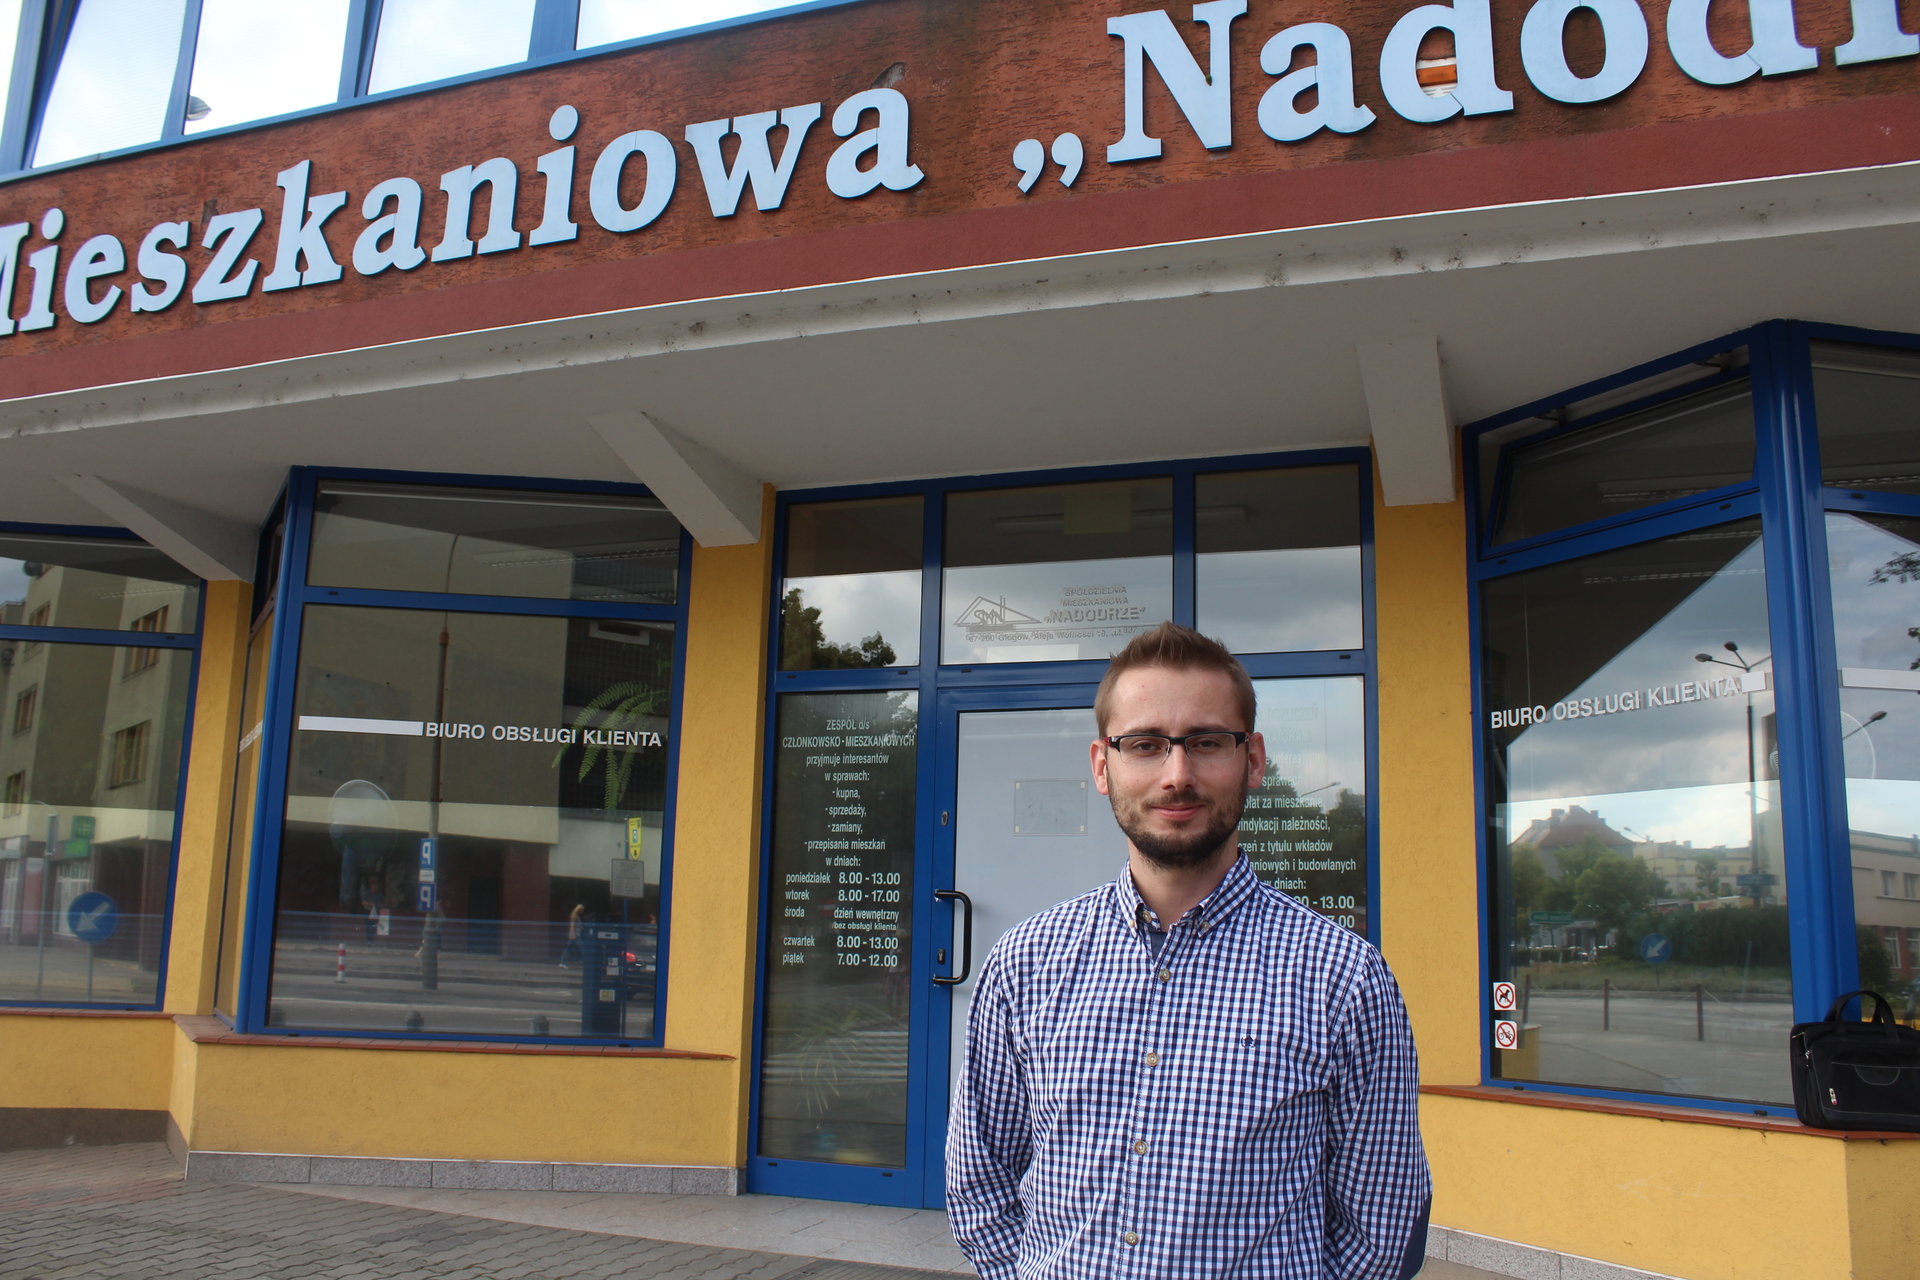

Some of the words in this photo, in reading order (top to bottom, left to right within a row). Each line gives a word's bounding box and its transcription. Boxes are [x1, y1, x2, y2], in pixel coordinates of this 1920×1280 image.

[1491, 704, 1547, 729] BIURO
[1553, 690, 1641, 721] OBSŁUGI
[1648, 675, 1740, 708] KLIENTA
[826, 718, 857, 731] ZESPÓŁ
[858, 719, 870, 730] d/s
[425, 721, 486, 740] BIURO
[492, 724, 577, 745] OBSŁUGI
[583, 728, 663, 748] KLIENTA
[806, 754, 841, 767] przyjmuje
[842, 753, 890, 765] interesantów
[824, 772, 831, 781] w
[832, 770, 870, 784] sprawach:
[1262, 798, 1272, 809] za
[1281, 816, 1331, 834] należności,
[851, 839, 886, 850] mieszkań
[1259, 842, 1266, 852] z
[1267, 841, 1293, 856] tytułu
[1294, 839, 1334, 852] wkładów
[825, 856, 832, 866] w
[833, 855, 861, 867] dniach:
[1249, 859, 1290, 874] aniowych
[1298, 859, 1357, 875] budowlanych
[785, 872, 831, 886] poniedziałek
[838, 872, 863, 884] 8.00
[871, 873, 901, 885] 13.00
[1274, 878, 1307, 890] dniach:
[785, 889, 810, 901] wtorek
[837, 889, 862, 902] 8.00
[871, 890, 900, 903] 17.00
[1319, 896, 1355, 909] 13.00
[784, 906, 805, 918] środa
[833, 907, 854, 919] dzień
[855, 909, 900, 923] wewnętrzny
[847, 921, 873, 932] obsługi
[783, 935, 816, 947] czwartek
[836, 936, 861, 948] 8.00
[868, 937, 899, 949] 13.00
[782, 952, 805, 966] piątek
[837, 953, 860, 966] 7.00
[868, 954, 898, 967] 12.00
